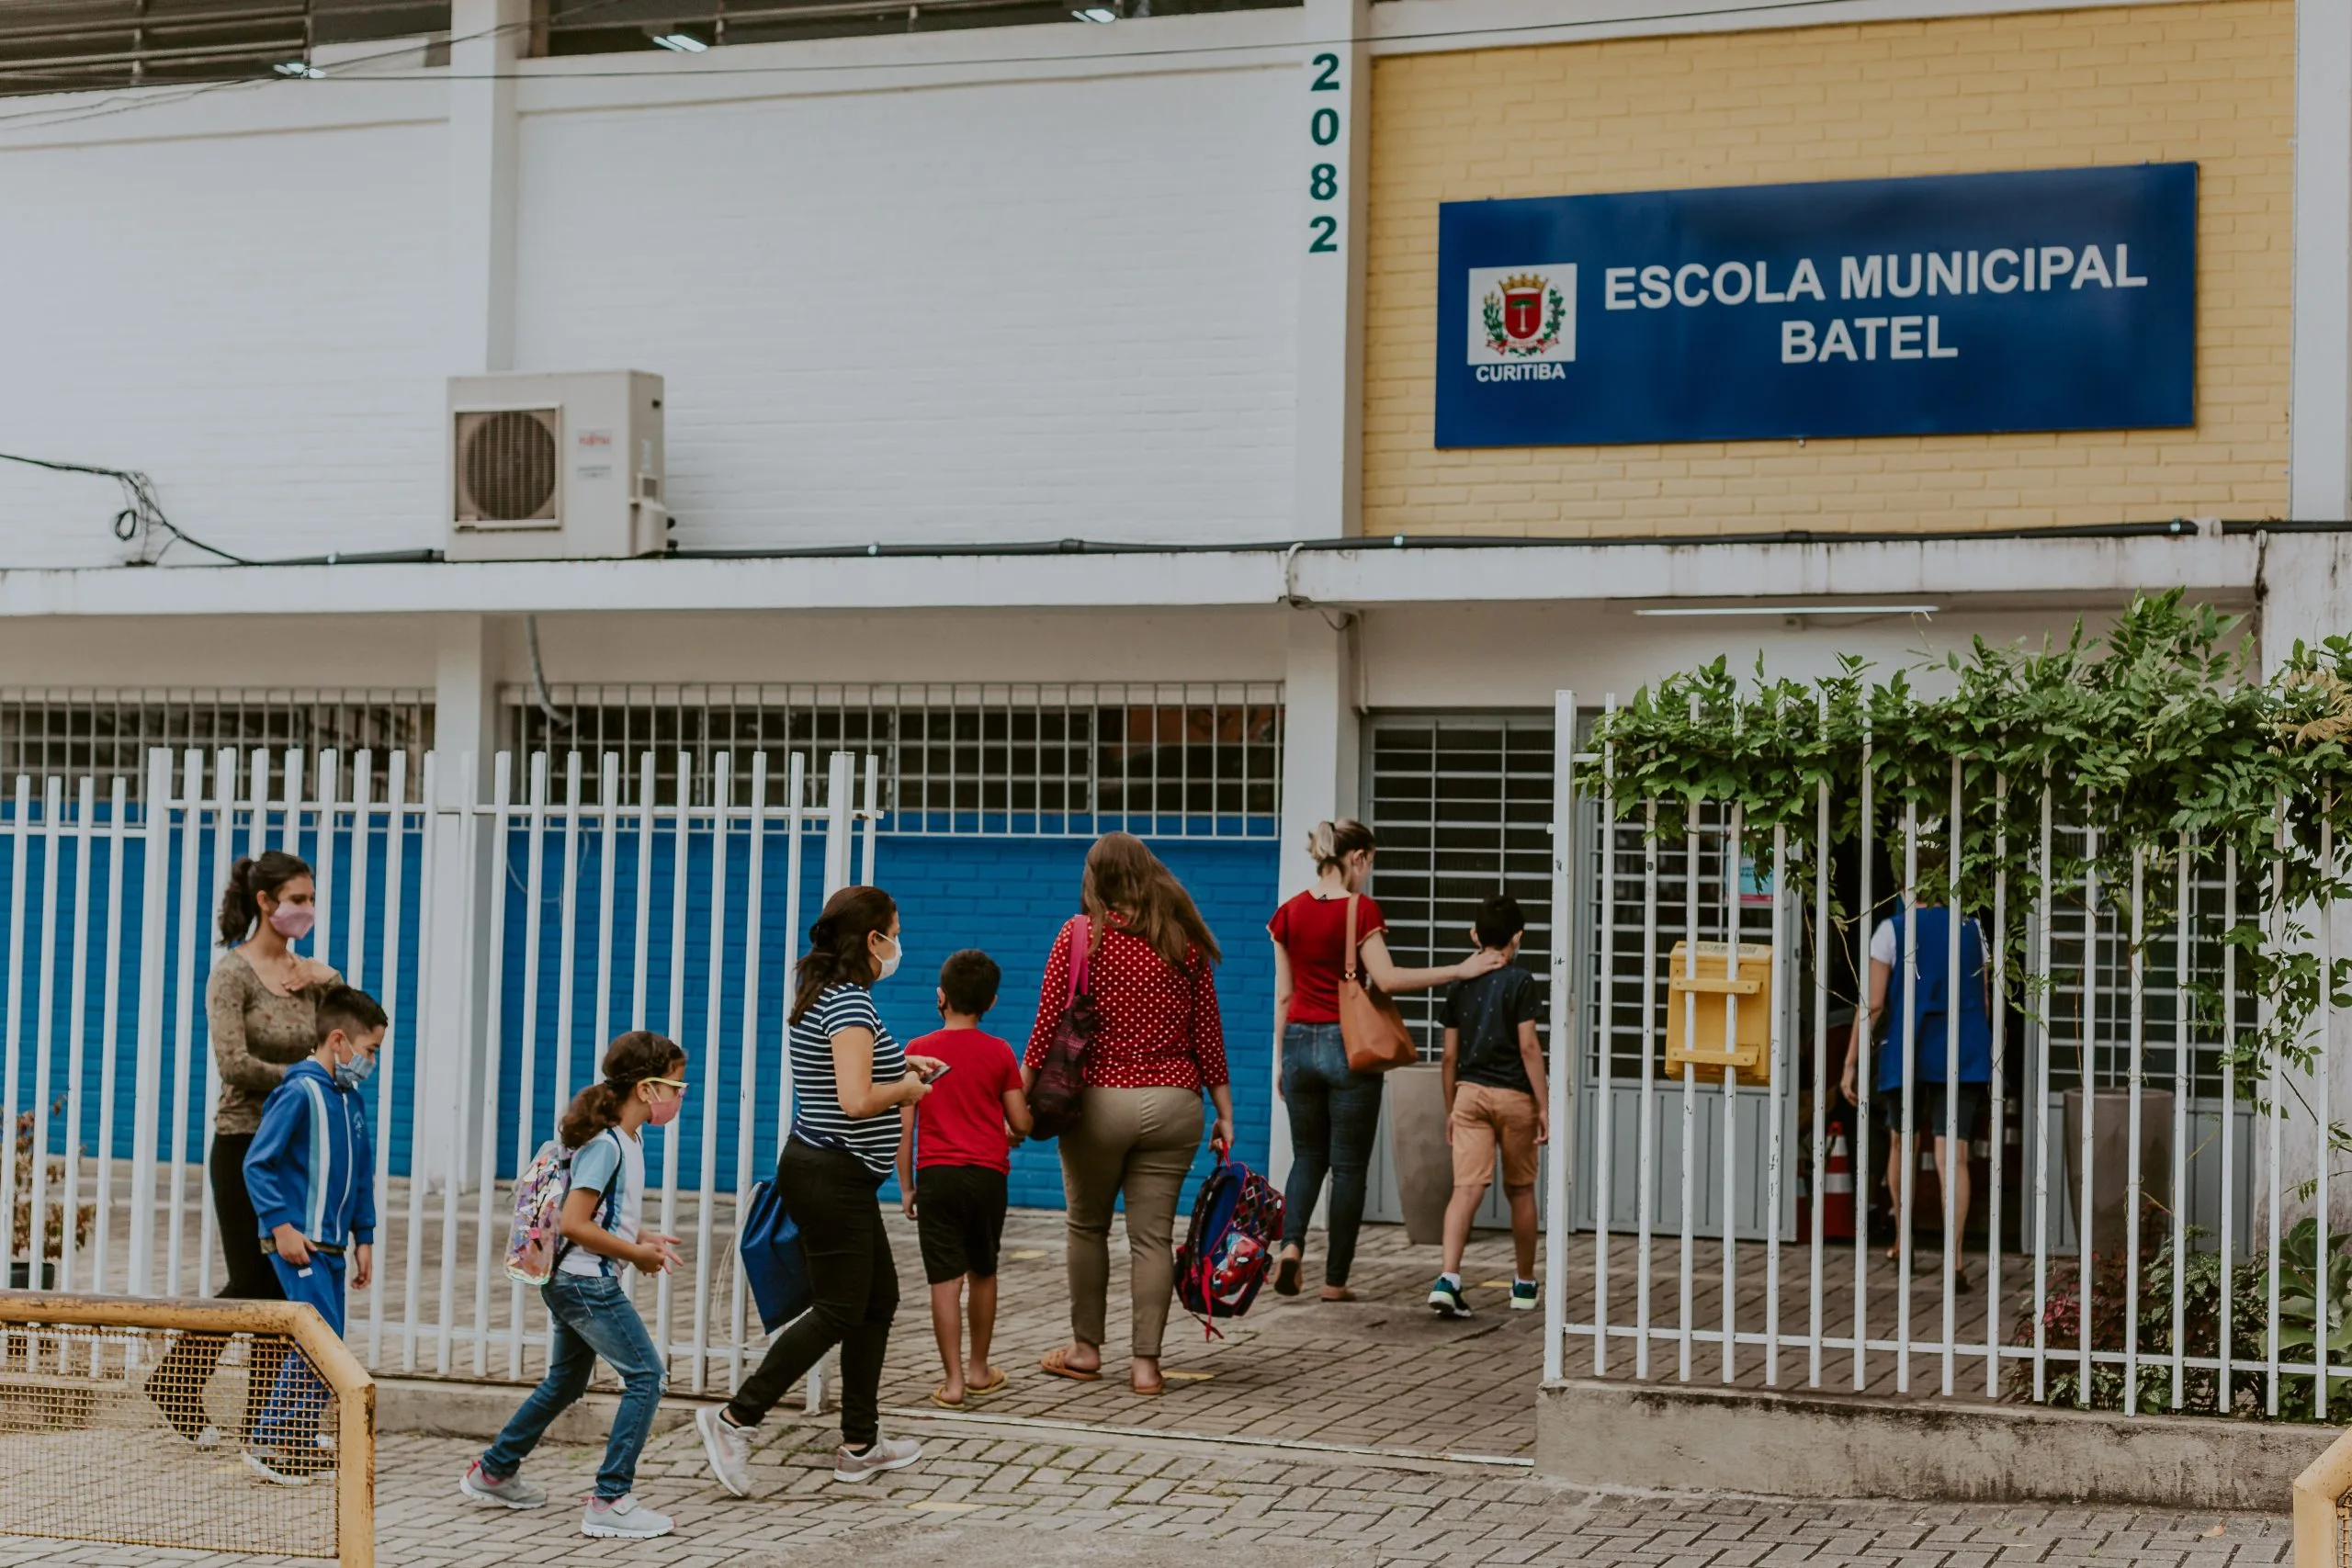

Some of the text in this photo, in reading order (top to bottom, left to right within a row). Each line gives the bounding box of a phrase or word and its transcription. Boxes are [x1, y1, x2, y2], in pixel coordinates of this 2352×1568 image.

[1309, 52, 1340, 254] 2082
[1604, 243, 2148, 310] ESCOLA MUNICIPAL
[1782, 315, 1959, 364] BATEL
[1476, 363, 1566, 383] CURITIBA
